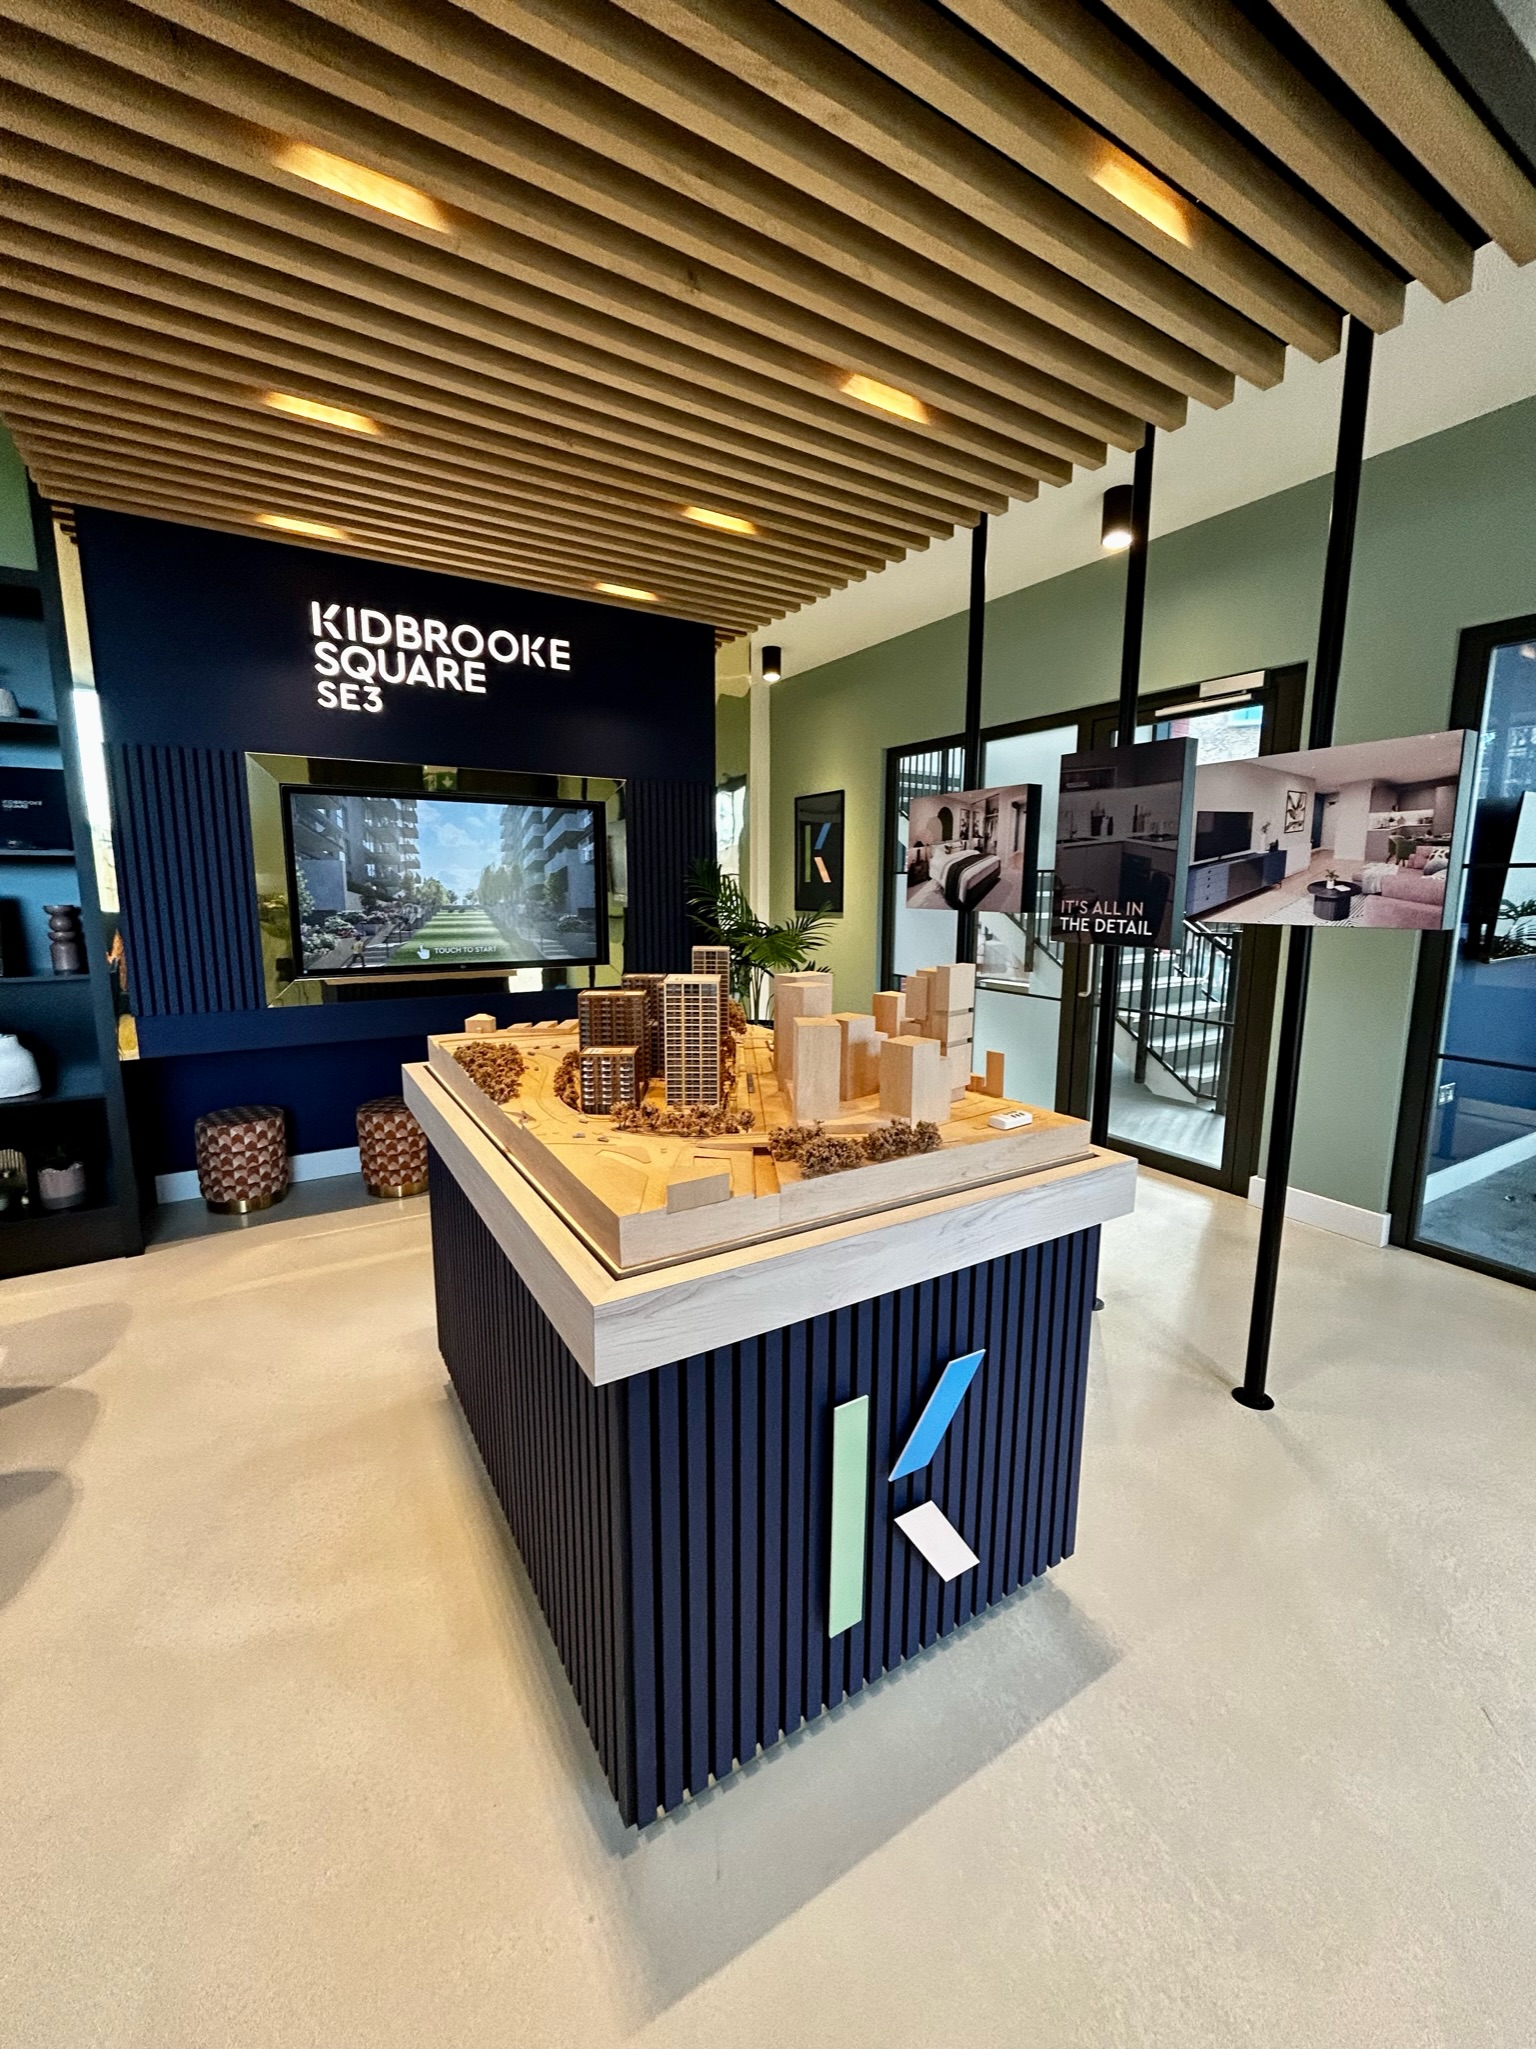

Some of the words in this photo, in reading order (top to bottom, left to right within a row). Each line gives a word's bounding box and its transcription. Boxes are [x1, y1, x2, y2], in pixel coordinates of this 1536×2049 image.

[311, 601, 571, 671] KIDBROOKE
[314, 641, 487, 694] SQUARE
[317, 680, 384, 713] SE3
[1061, 900, 1088, 914] IT'S
[1092, 901, 1121, 915] ALL
[1126, 901, 1144, 916] IN
[1060, 917, 1090, 932] THE
[1094, 918, 1152, 936] DETAIL
[475, 945, 497, 953] START
